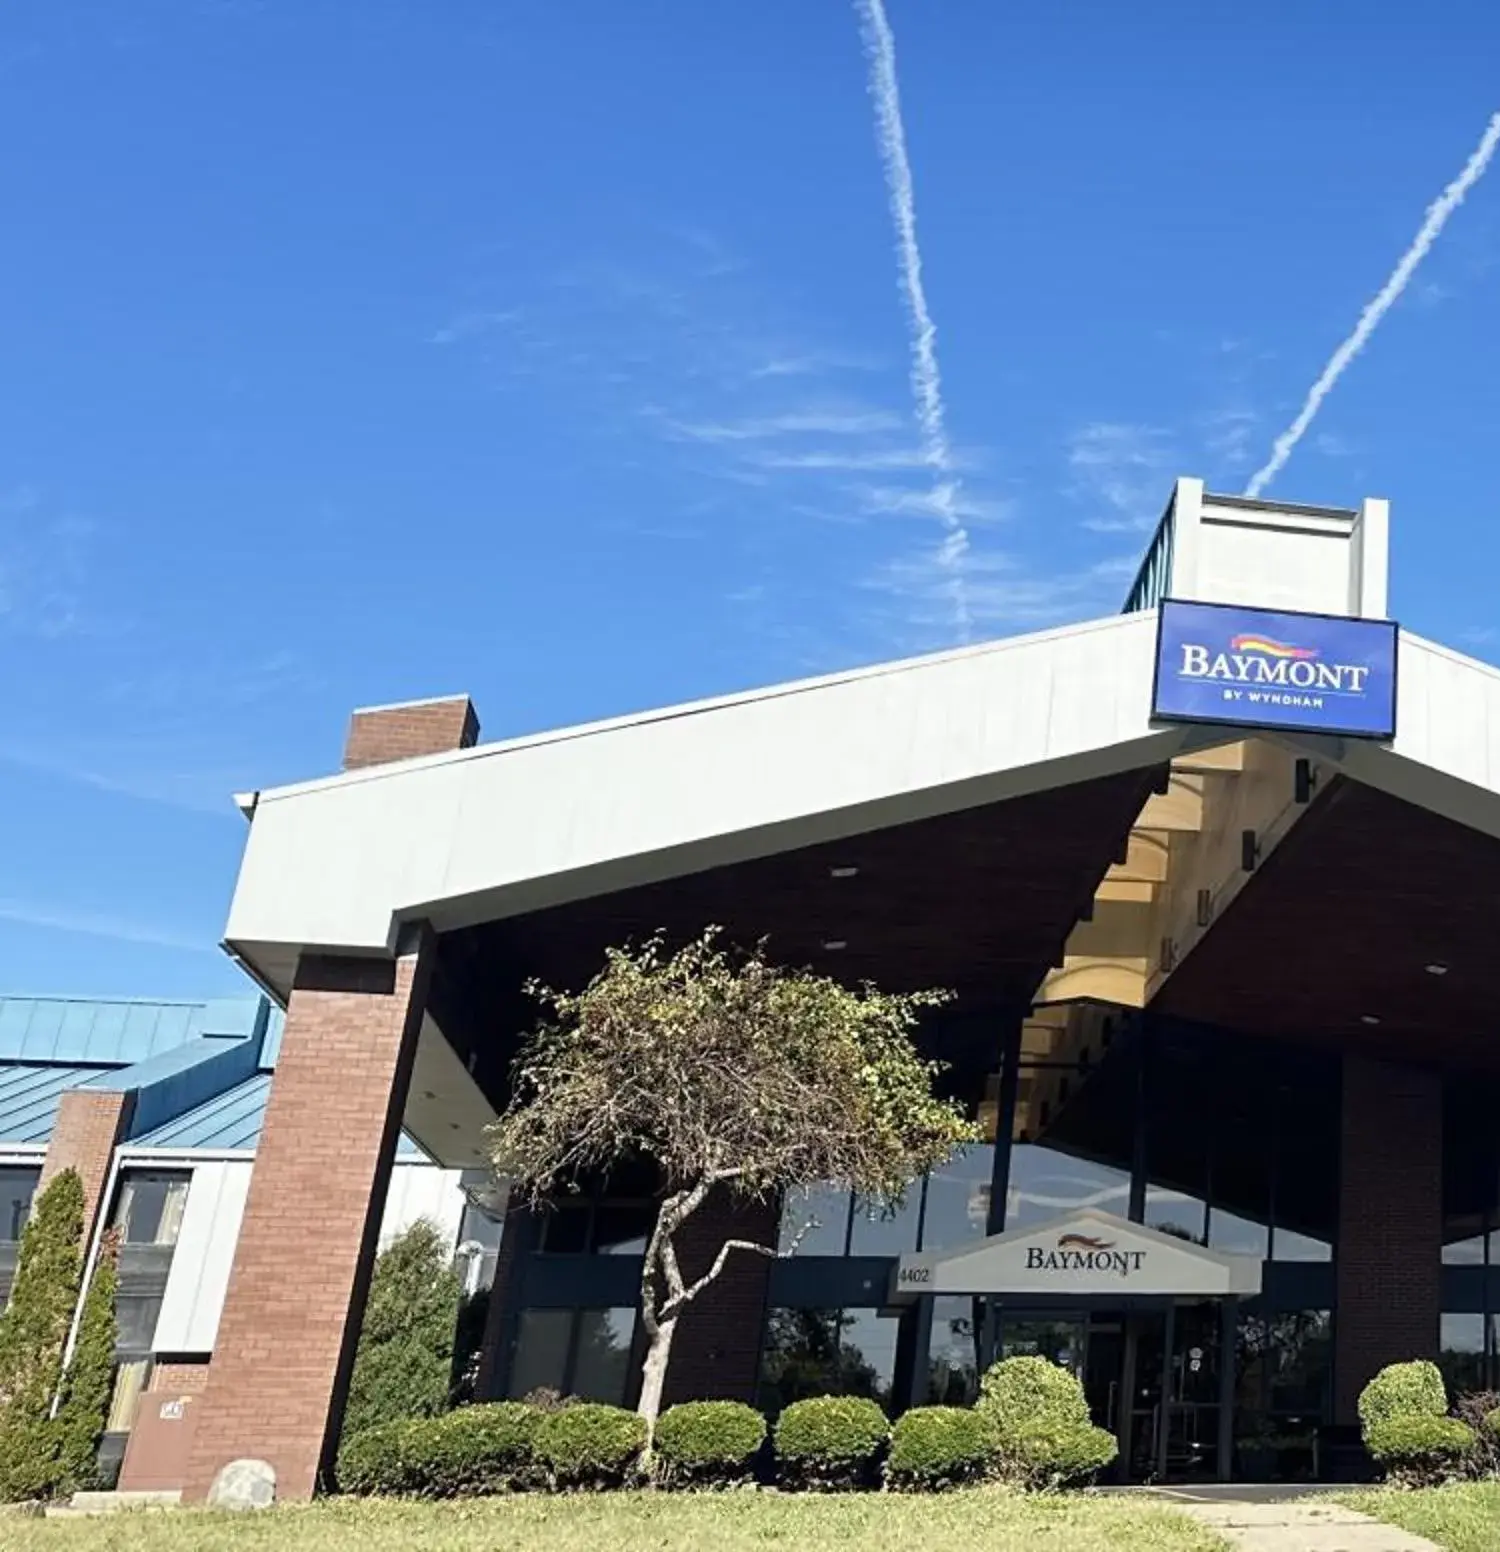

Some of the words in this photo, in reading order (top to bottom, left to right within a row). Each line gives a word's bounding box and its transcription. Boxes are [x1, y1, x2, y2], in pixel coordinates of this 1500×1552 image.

[1177, 644, 1368, 691] BAYMONT
[1223, 689, 1242, 700] BY
[1249, 692, 1323, 708] WYNDHAM
[1025, 1247, 1146, 1274] BAYMONT
[899, 1268, 929, 1283] 4402
